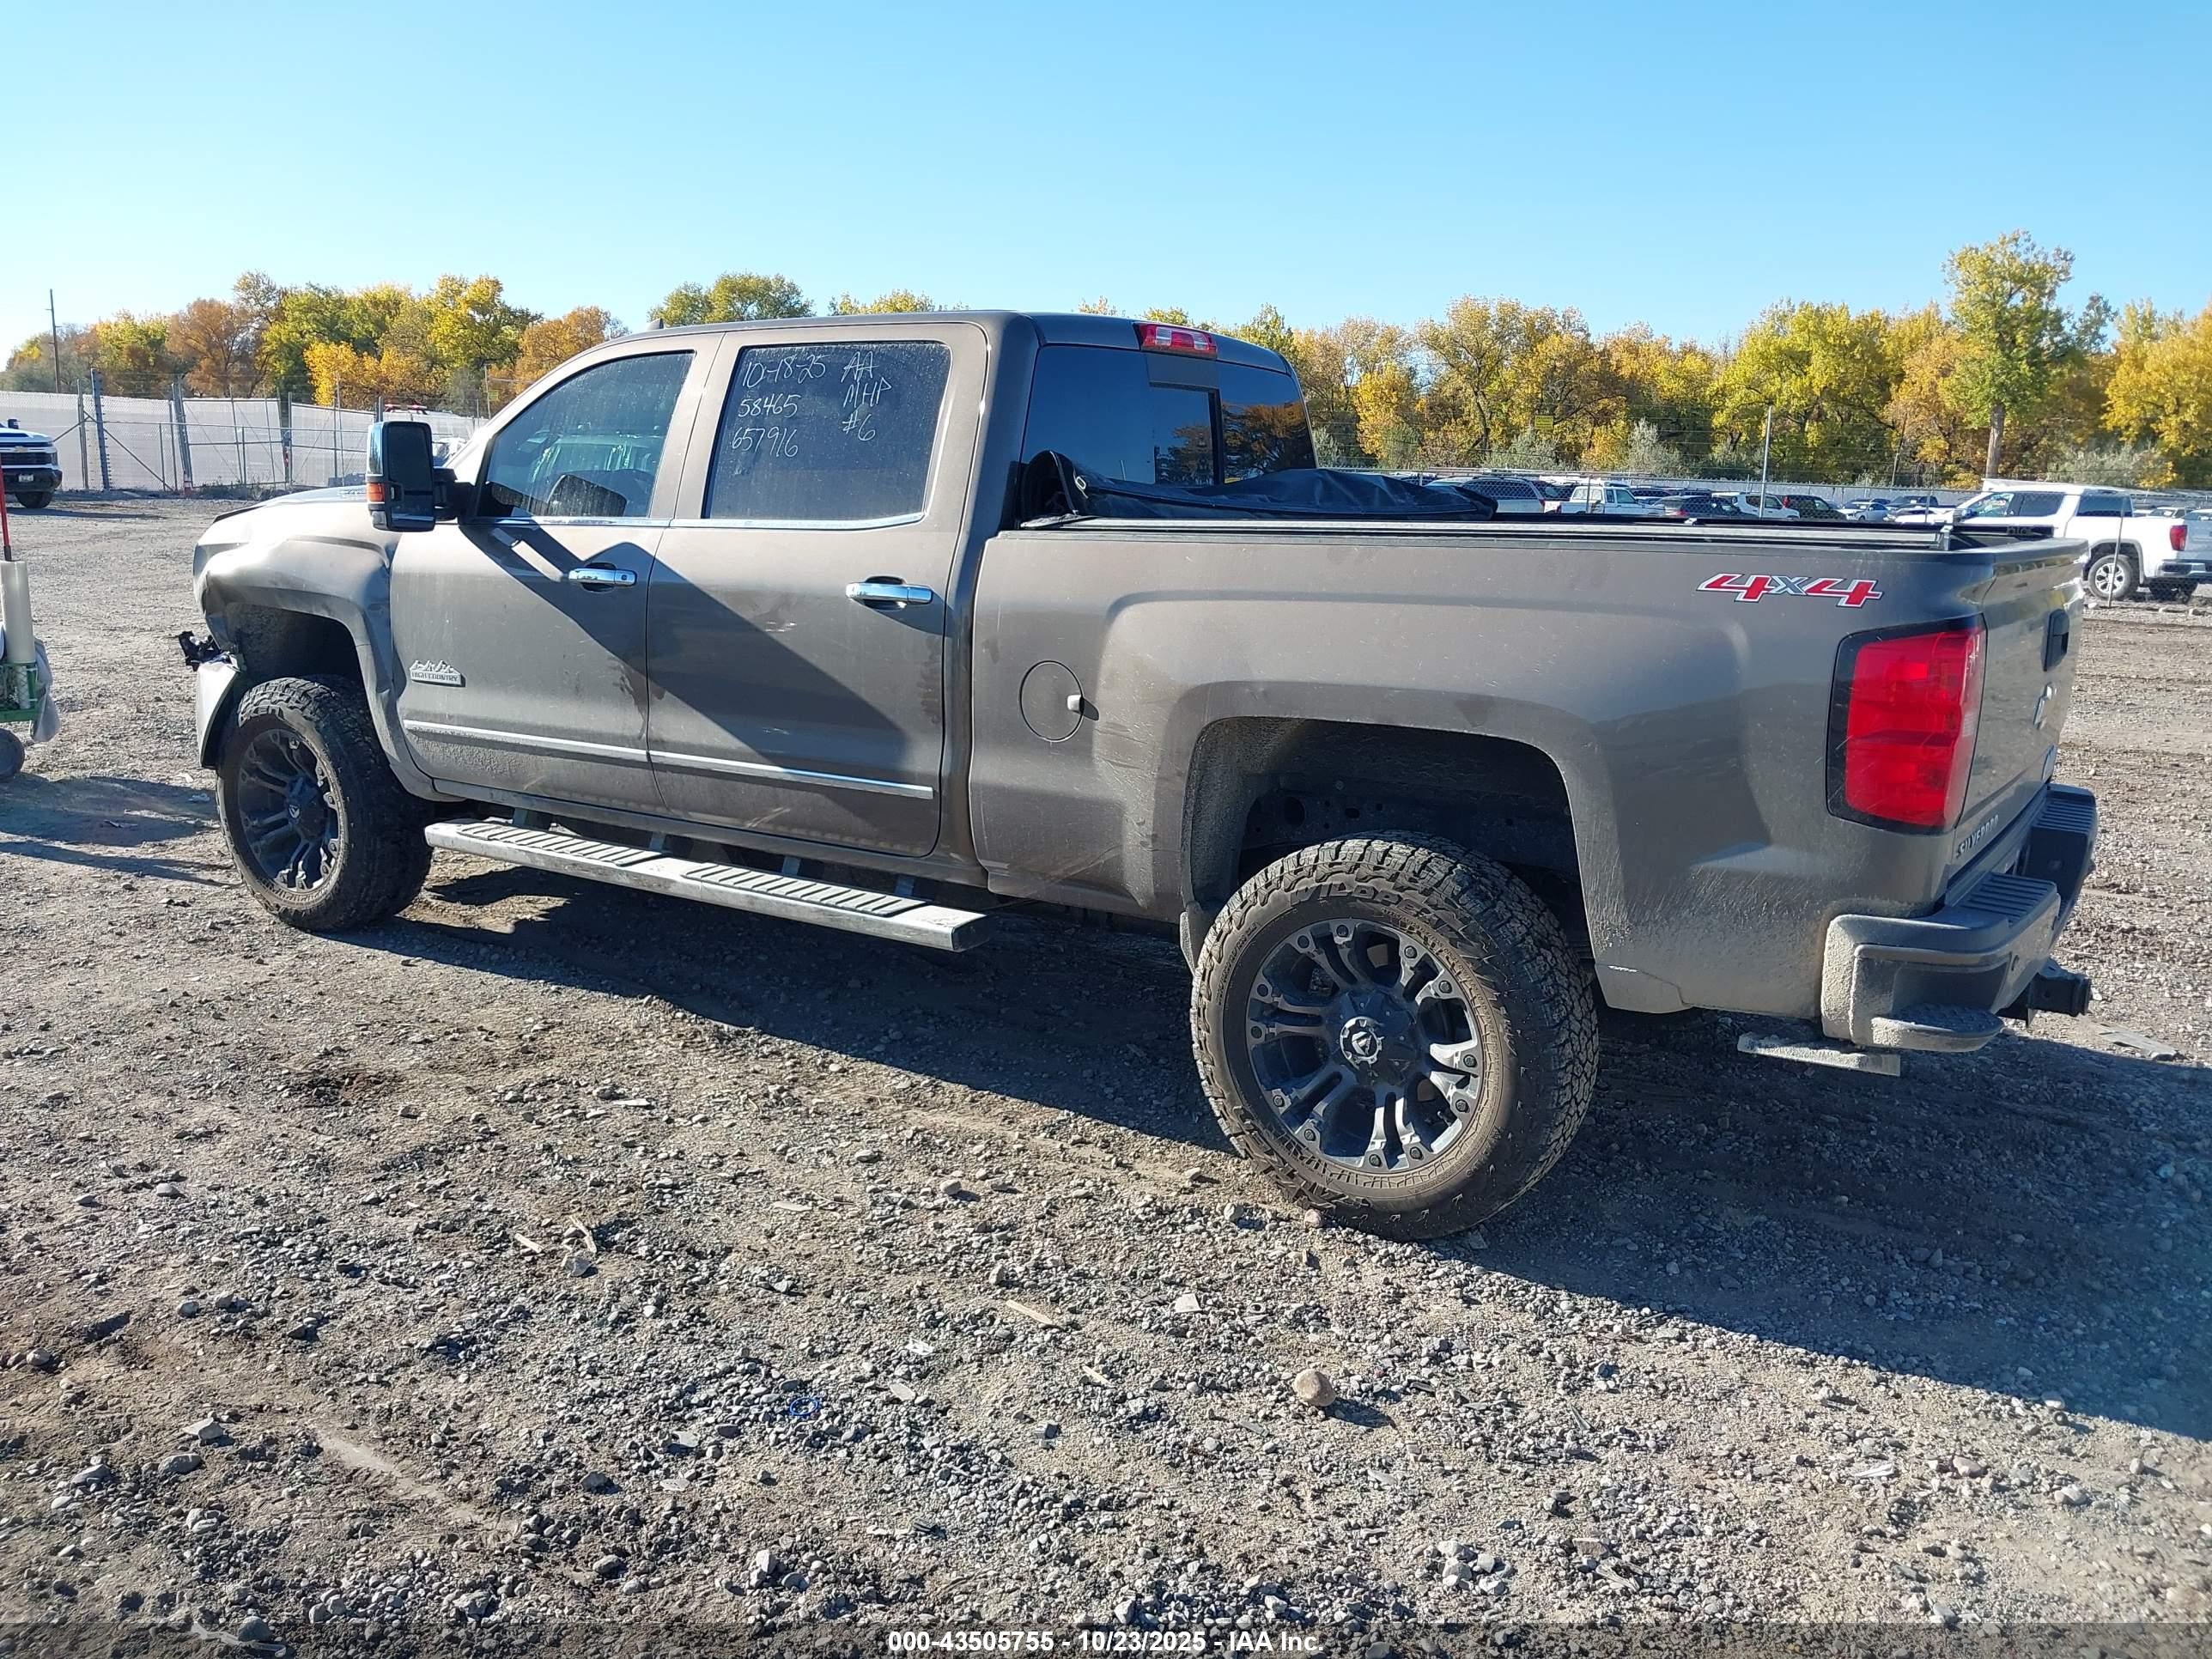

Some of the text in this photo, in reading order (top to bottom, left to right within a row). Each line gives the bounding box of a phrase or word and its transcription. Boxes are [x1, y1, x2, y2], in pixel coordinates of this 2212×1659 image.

[743, 354, 830, 388] 10-18-25
[738, 392, 802, 417] 58465
[730, 428, 799, 458] 657916
